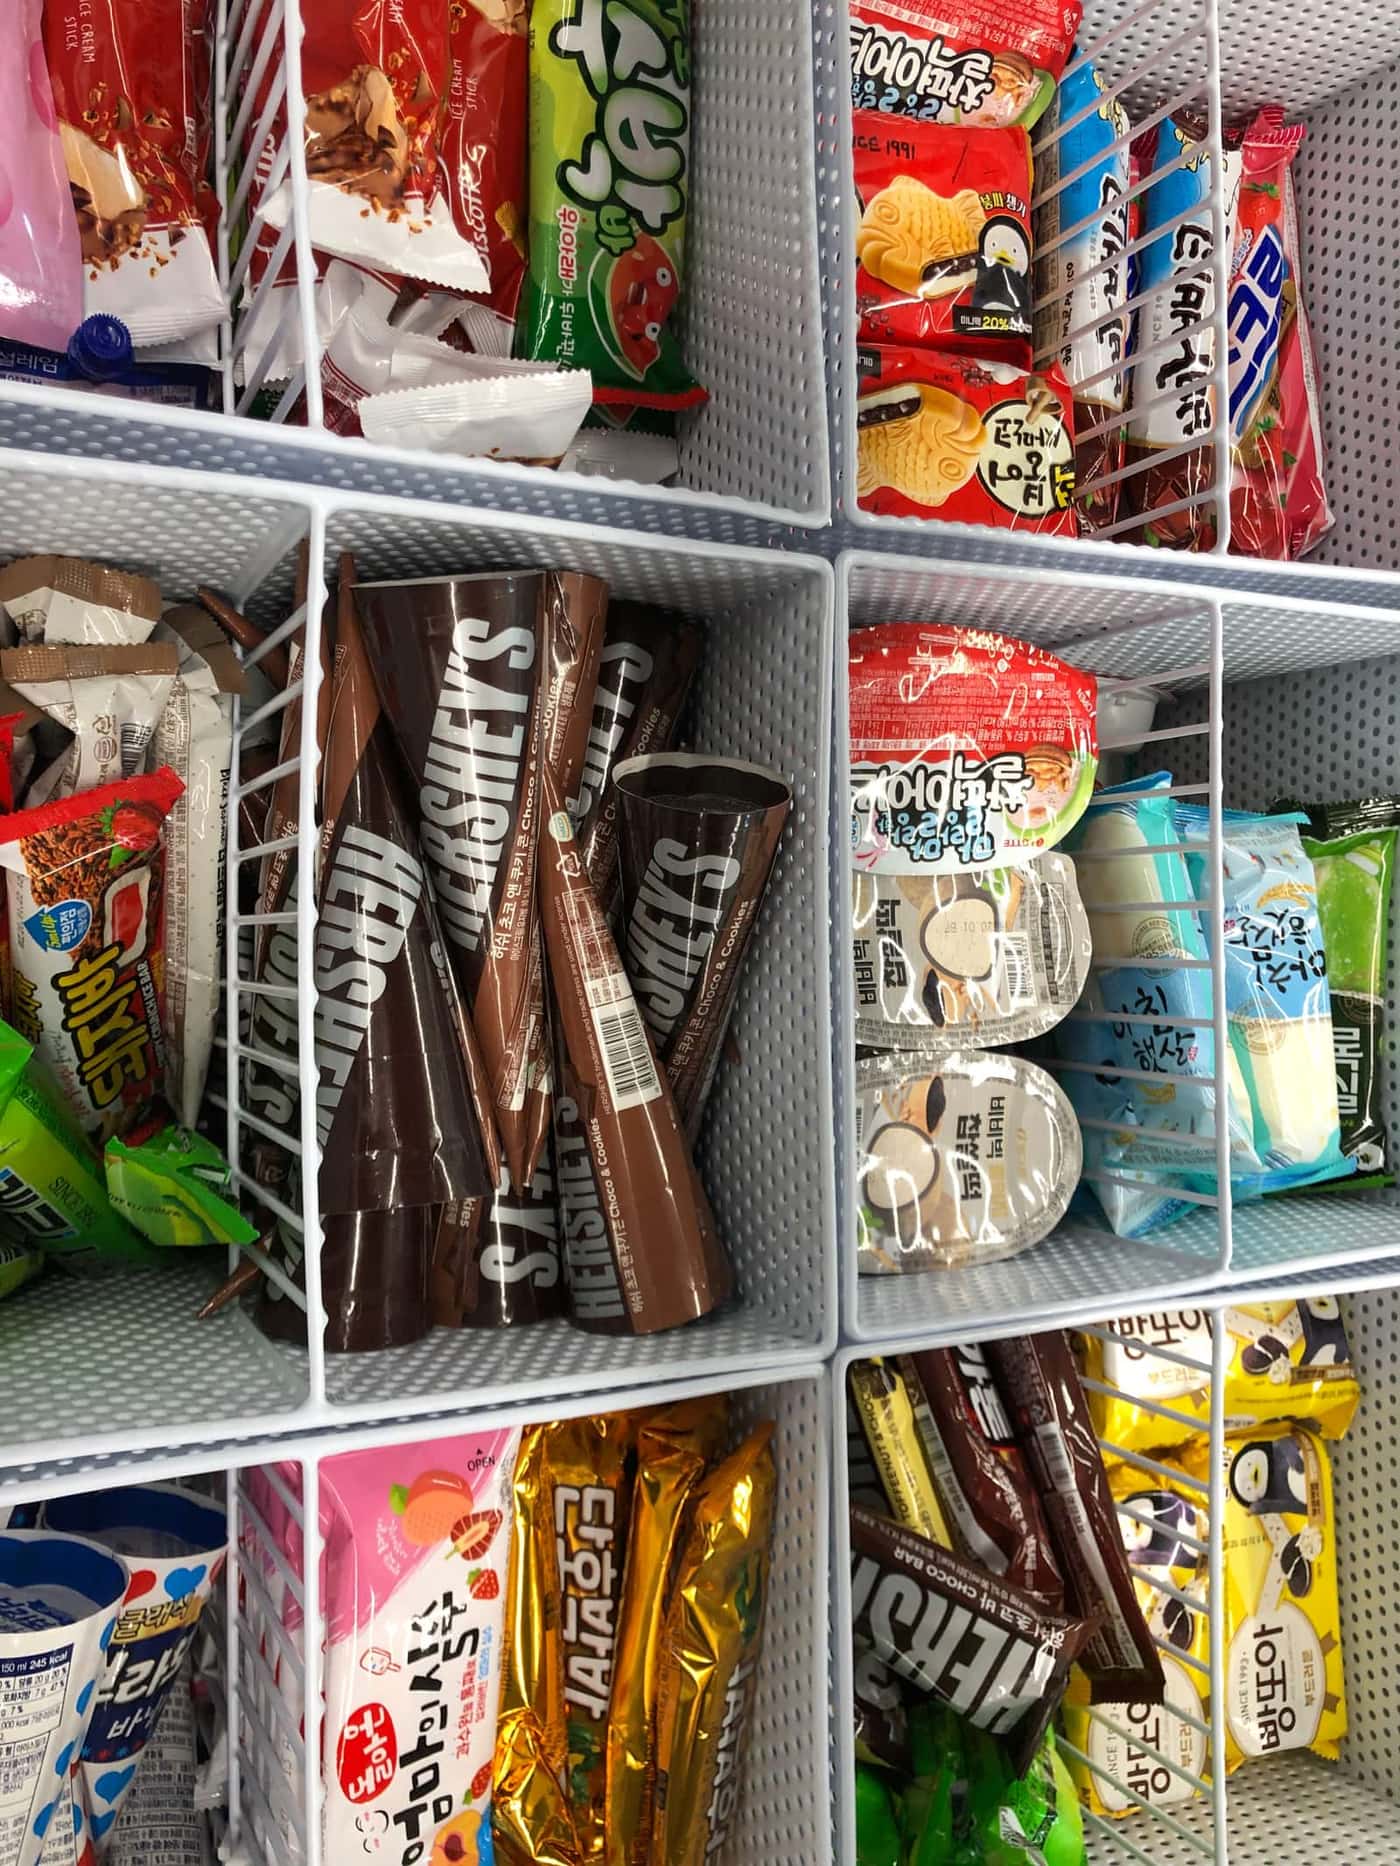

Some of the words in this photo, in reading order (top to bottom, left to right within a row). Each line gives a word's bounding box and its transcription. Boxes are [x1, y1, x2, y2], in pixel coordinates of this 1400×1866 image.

[64, 16, 79, 50] STICK
[81, 24, 96, 63] CREAM
[851, 26, 993, 114] 찰떡아이
[465, 75, 478, 110] STICK
[451, 101, 464, 119] ICE
[887, 139, 916, 160] 1991
[557, 205, 579, 296] 위아래가
[982, 315, 1009, 331] 20%
[993, 418, 1061, 450] 싸만코
[989, 451, 1047, 506] 붕어
[420, 612, 538, 954] HERSHEY'S
[519, 776, 539, 830] Choco
[513, 832, 529, 849] 콘
[509, 851, 528, 880] 쿠키
[505, 882, 522, 899] 앤
[60, 907, 78, 943] 편의점
[499, 901, 518, 929] 초코
[719, 898, 753, 958] Cookies
[1228, 909, 1307, 946] 햇살
[491, 931, 512, 960] 허쉬
[559, 921, 571, 944] under
[877, 899, 906, 987] 찹쌀떡
[565, 944, 576, 962] used
[1252, 946, 1324, 994] 아침
[136, 959, 151, 983] BAR
[573, 975, 585, 997] dress
[854, 939, 877, 1005] 비비빅
[578, 997, 589, 1018] trade
[695, 971, 724, 1017] Choco
[54, 942, 150, 1109] 돼지바
[582, 1017, 592, 1033] and
[687, 1013, 707, 1031] 콘
[678, 1028, 701, 1055] 쿠키
[671, 1051, 690, 1069] 앤
[590, 1118, 607, 1165] Cookies
[986, 1097, 1005, 1159] 비비빅
[956, 1114, 982, 1201] 찹쌀떡
[460, 1197, 476, 1228] kies
[604, 1179, 620, 1217] Choco
[612, 1218, 625, 1228] 콘
[615, 1231, 629, 1253] 쿠키
[621, 1254, 633, 1266] 앤
[624, 1269, 638, 1288] 초코
[628, 1293, 644, 1312] 허쉬
[466, 1457, 497, 1472] OPEN
[891, 1544, 926, 1571] BAR
[924, 1560, 980, 1600] CHOCO
[115, 1598, 191, 1639] 클래식
[554, 1486, 618, 1720] 단호박바
[976, 1589, 1001, 1614] 바
[995, 1601, 1032, 1631] 초코
[406, 1591, 480, 1691] 실수
[0, 1662, 16, 1674] 150
[17, 1661, 28, 1672] ml
[29, 1657, 48, 1672] 245
[49, 1649, 68, 1667] kcal
[1237, 1657, 1251, 1686] 1993
[1302, 1649, 1315, 1707] 부드러운
[460, 1658, 477, 1700] 통째로
[1251, 1623, 1297, 1751] 빵또아
[1235, 1688, 1255, 1724] SINCE
[456, 1702, 472, 1759] 과수원을
[343, 1706, 394, 1800] 돌아온
[394, 1699, 453, 1865] 엄마의
